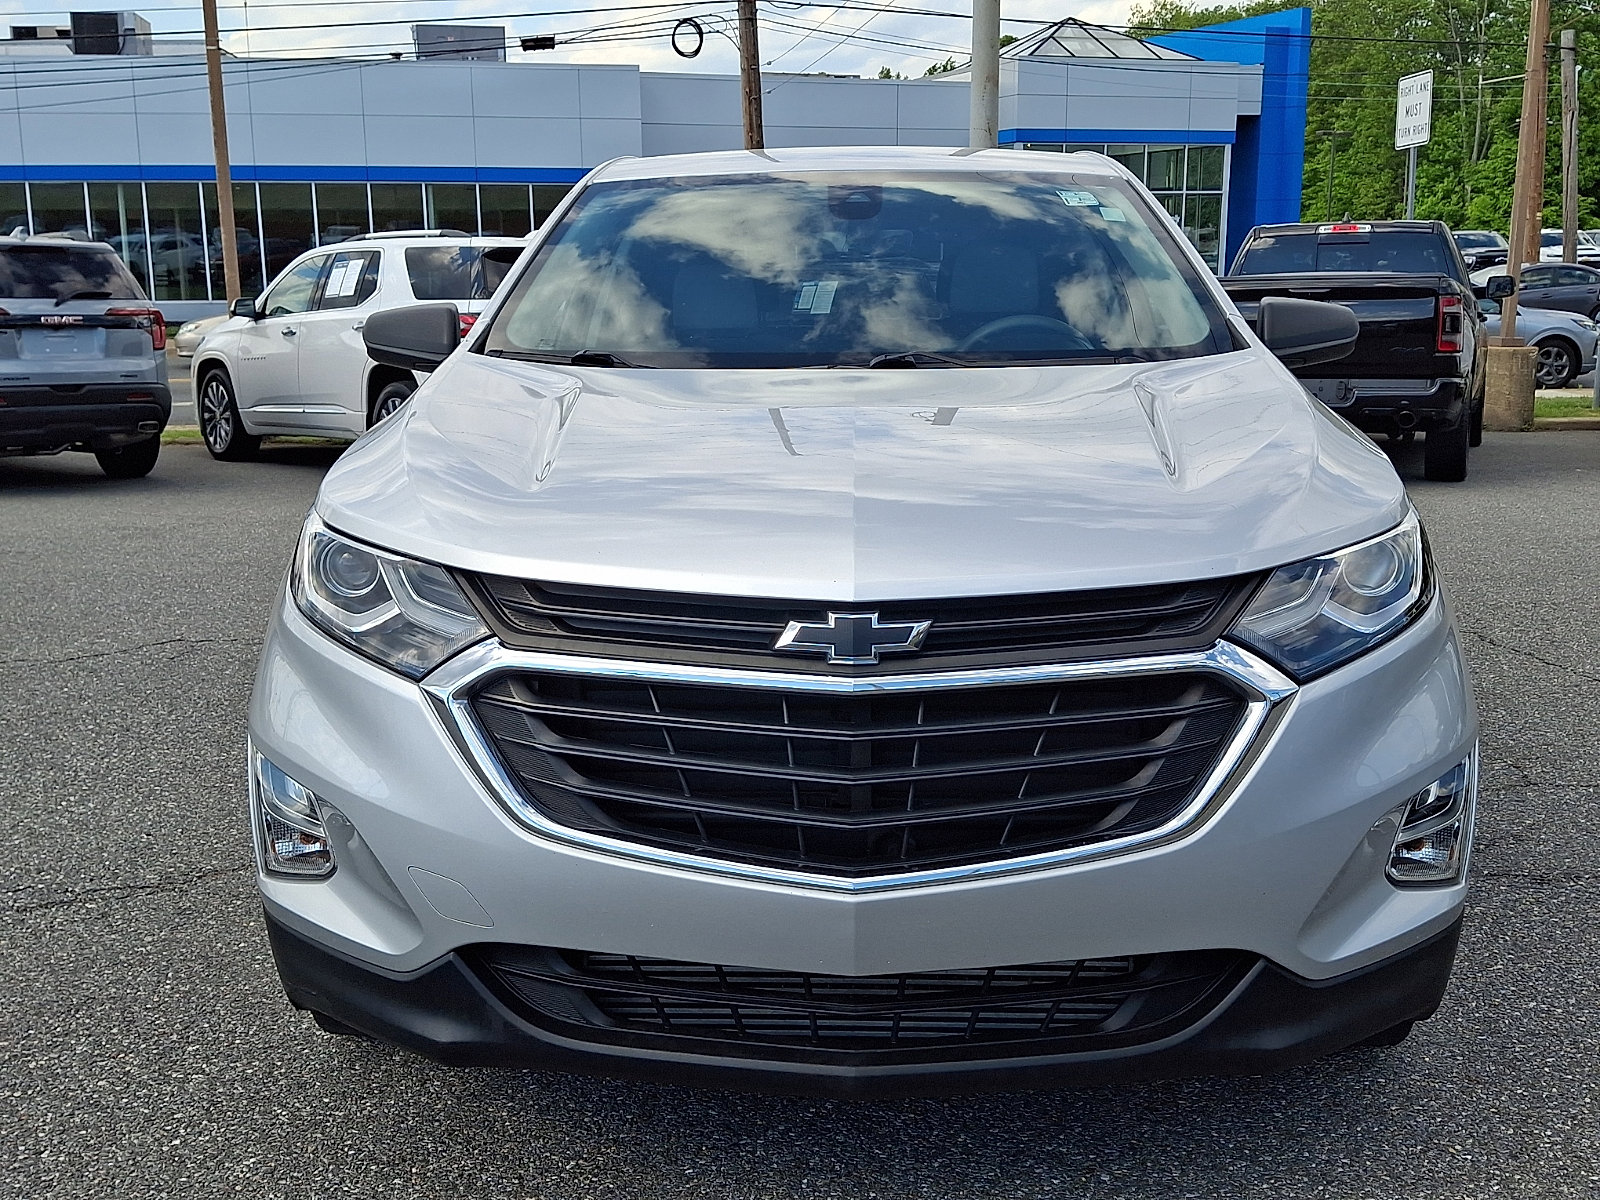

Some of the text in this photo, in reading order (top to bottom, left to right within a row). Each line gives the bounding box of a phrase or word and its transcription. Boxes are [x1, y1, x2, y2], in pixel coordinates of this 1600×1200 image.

[1401, 81, 1430, 97] RIGHT LANE
[1405, 103, 1422, 118] MUST
[1398, 123, 1427, 139] TURN RIGHT
[41, 316, 83, 325] GMC
